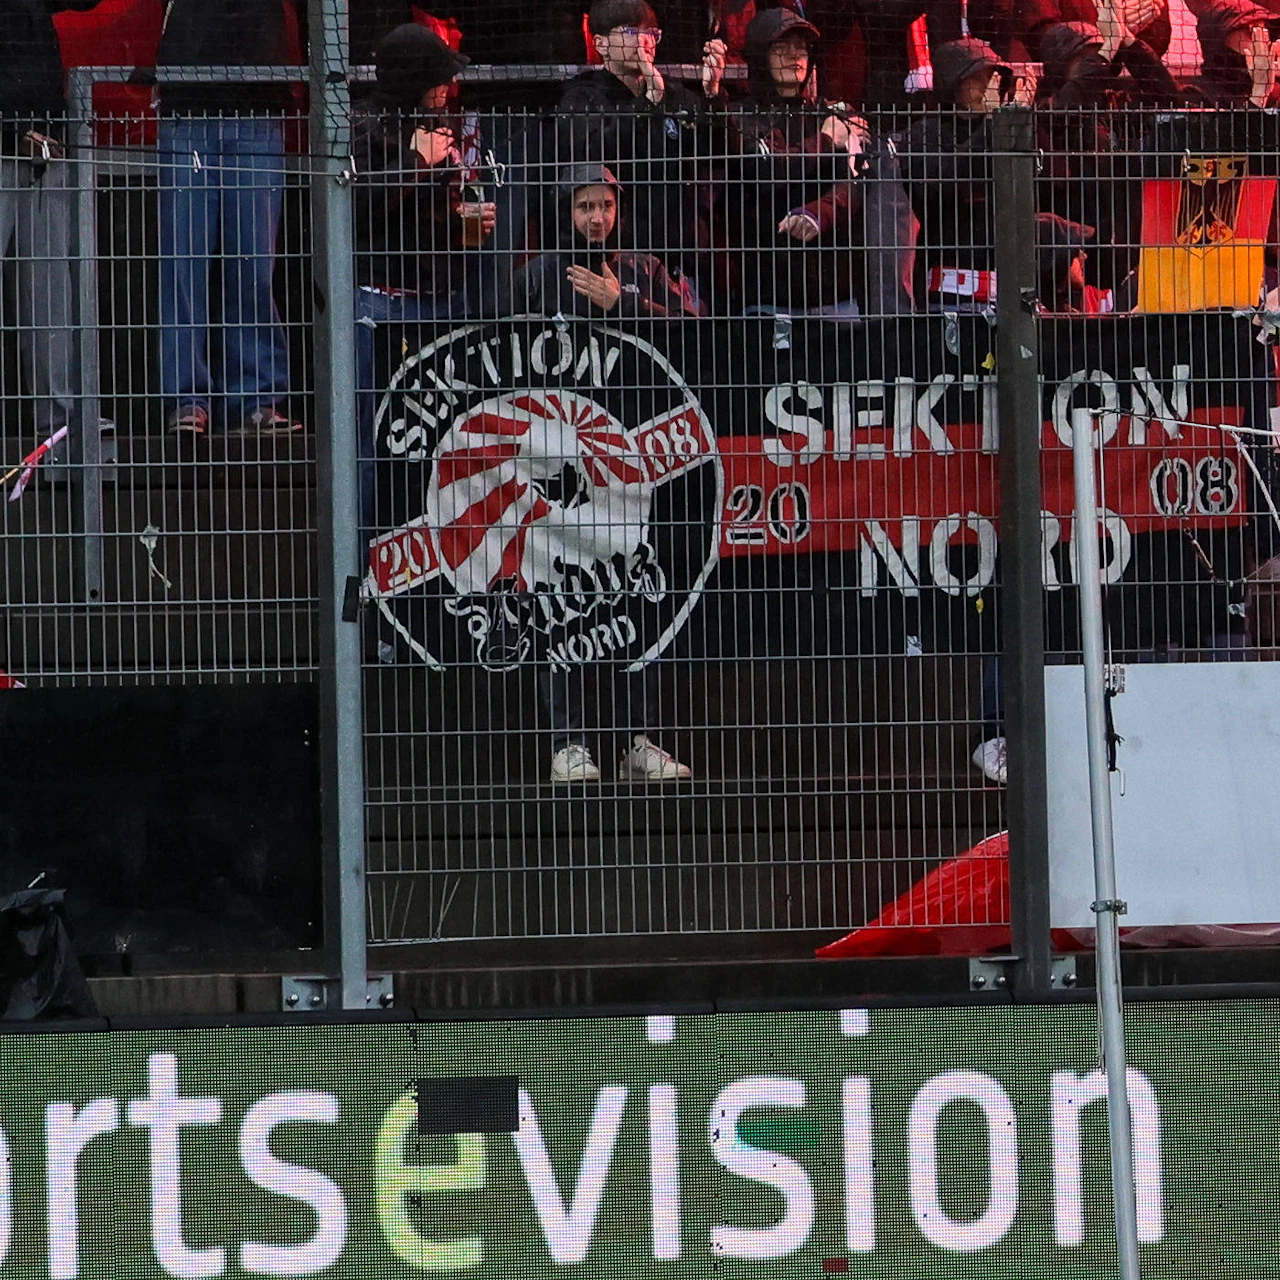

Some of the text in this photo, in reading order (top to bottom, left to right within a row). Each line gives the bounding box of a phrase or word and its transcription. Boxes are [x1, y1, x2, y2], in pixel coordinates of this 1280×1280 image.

[386, 328, 620, 464] SEKTION
[762, 363, 1191, 468] SEKTON
[644, 417, 700, 475] 08
[726, 456, 1239, 546] 20 08
[379, 531, 432, 588] 20
[546, 614, 638, 674] NORD
[0, 1009, 1164, 1280] rtsevision
